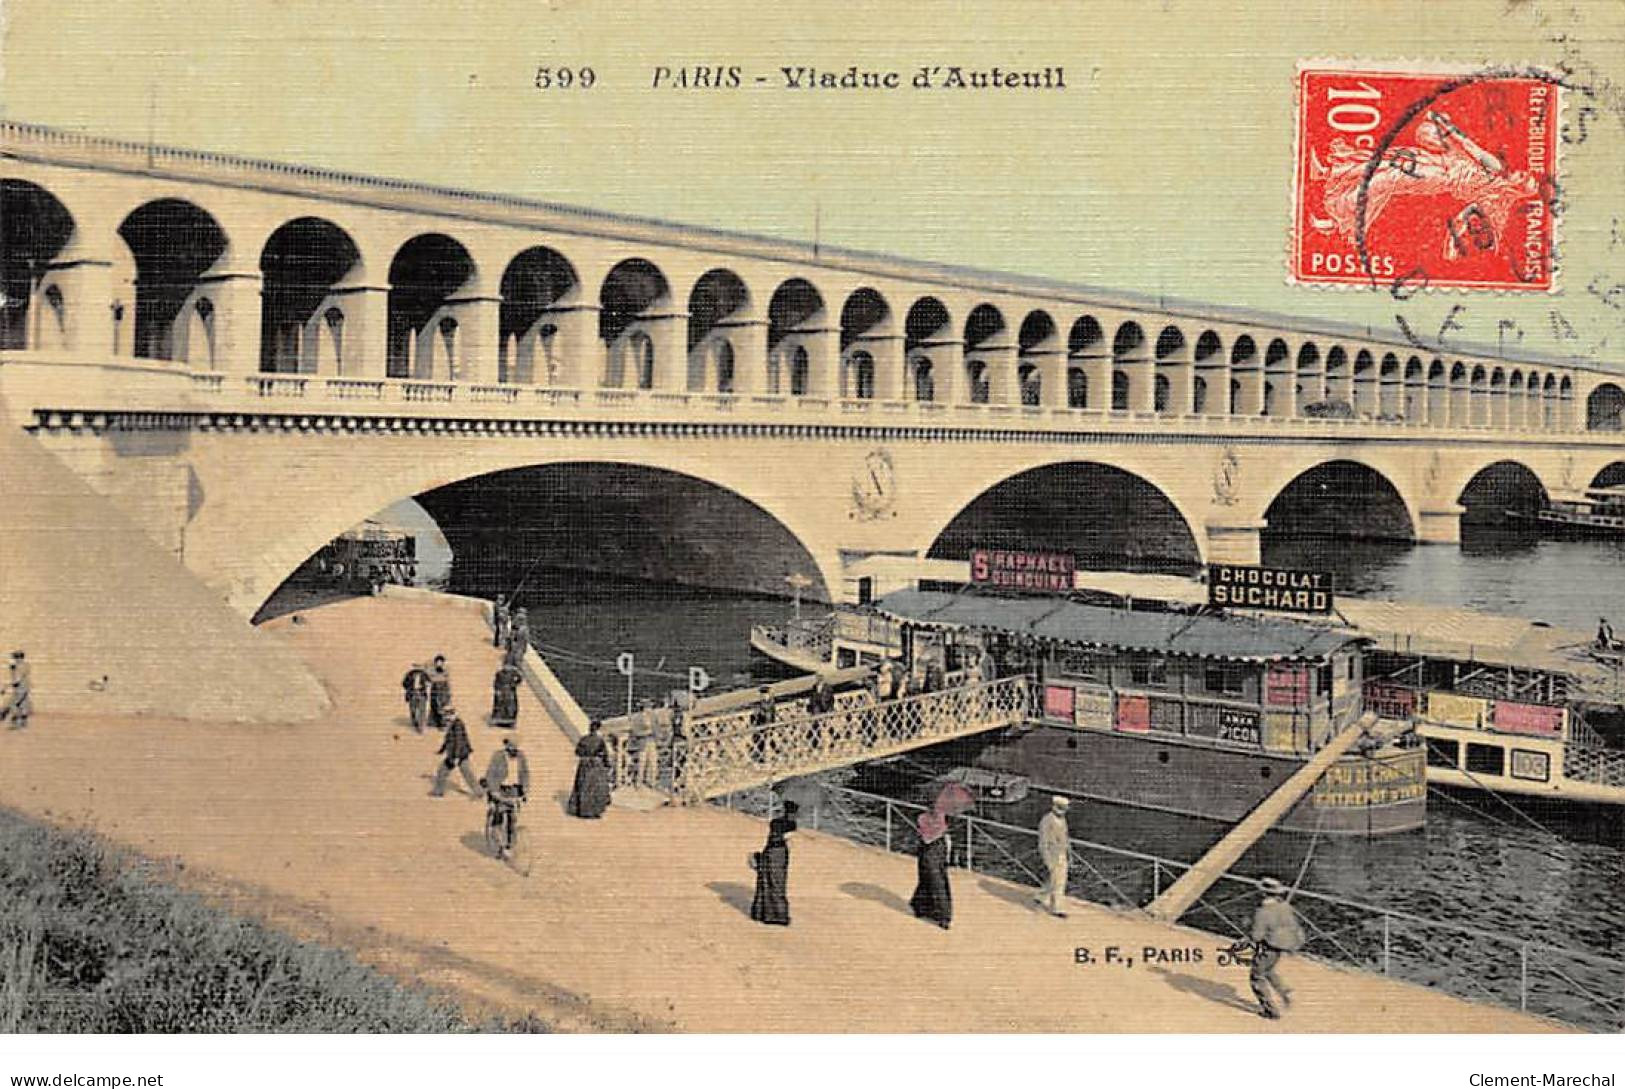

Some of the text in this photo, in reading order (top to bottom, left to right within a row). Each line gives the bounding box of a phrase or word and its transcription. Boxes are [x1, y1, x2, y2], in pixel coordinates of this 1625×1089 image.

[534, 68, 597, 89] 599
[652, 66, 743, 89] PARIS
[781, 67, 900, 89] Viaduc
[1311, 252, 1395, 276] POSTES
[1221, 567, 1322, 588] CHOCOLAT
[1215, 585, 1326, 611] SUCHARD
[1219, 726, 1260, 742] PICON
[1074, 947, 1096, 964] B.
[1143, 947, 1203, 963] PARIS
